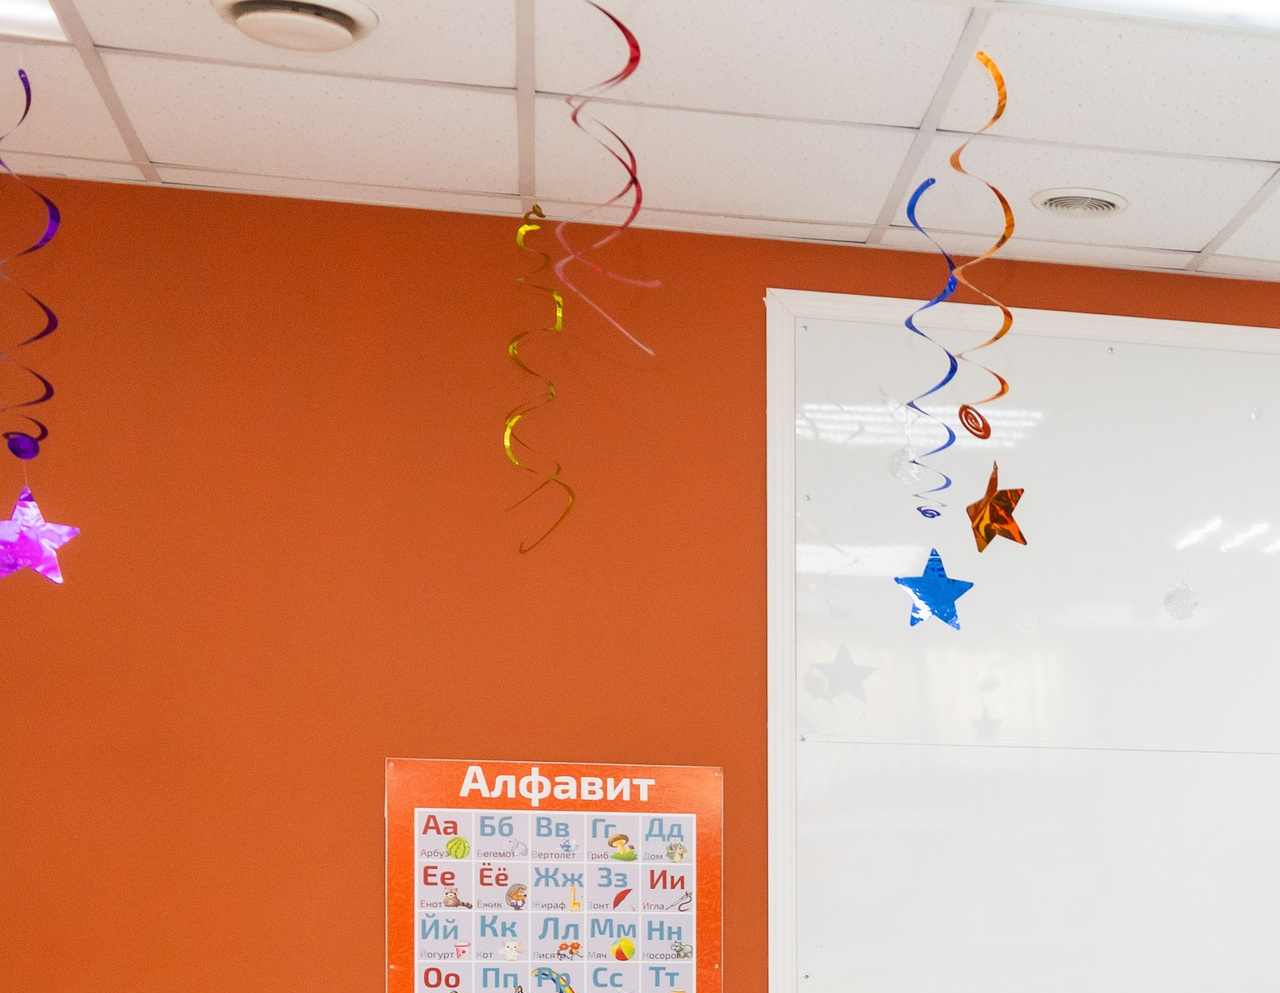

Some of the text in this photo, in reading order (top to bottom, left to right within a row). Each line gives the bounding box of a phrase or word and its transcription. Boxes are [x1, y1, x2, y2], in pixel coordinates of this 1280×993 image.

[459, 765, 655, 807] Алфавит
[422, 815, 458, 835] Аа
[479, 815, 514, 837] Бб
[536, 816, 570, 838] Вв
[592, 818, 616, 838] Гг
[645, 818, 684, 842] Дд
[587, 851, 609, 861] Гриб
[643, 852, 663, 861] Дом
[423, 866, 455, 886] Ее
[479, 862, 509, 887] Ёё
[533, 867, 584, 887] Жж
[597, 867, 628, 888] Зз
[649, 869, 685, 890] Ии
[420, 900, 443, 908] Енот
[531, 901, 566, 911] Жираф
[587, 901, 609, 910] Зонт
[642, 902, 665, 910] Игла
[421, 913, 458, 940] Йй
[480, 915, 518, 938] Кк
[538, 917, 579, 940] Лл
[590, 918, 637, 938] Мм
[647, 920, 682, 940] Нн
[420, 949, 455, 960] Йогурт
[476, 951, 494, 959] Кот
[587, 951, 607, 959] Мяч
[423, 967, 461, 988] Оо
[482, 967, 518, 988] Пп
[536, 967, 571, 993] Рр
[592, 967, 623, 988] Сс
[649, 966, 680, 987] Тт
